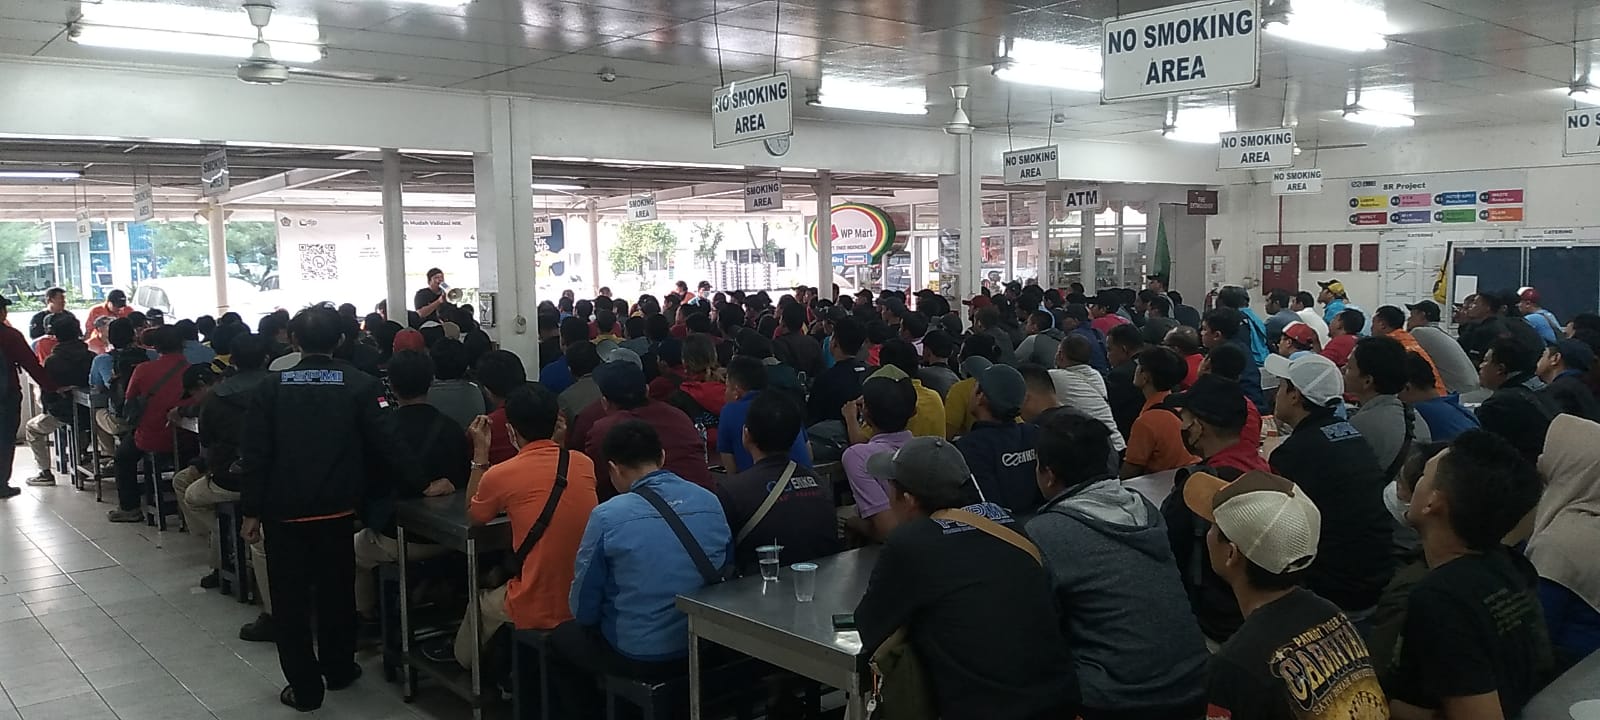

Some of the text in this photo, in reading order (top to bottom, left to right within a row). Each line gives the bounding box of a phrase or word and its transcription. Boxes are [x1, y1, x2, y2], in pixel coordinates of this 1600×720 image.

[1108, 9, 1253, 54] NO SMOKING
[1145, 55, 1206, 85] AREA
[715, 81, 787, 113] NO SMOKING
[735, 113, 766, 134] AREA
[1568, 114, 1590, 129] NO
[1221, 132, 1292, 148] NO SMOKING
[1005, 150, 1056, 167] NO SMOKING
[1240, 151, 1270, 164] AREA
[1020, 167, 1041, 179] AREA
[1273, 170, 1321, 181] NO SMOKING
[746, 183, 779, 196] SMOKING
[1287, 182, 1307, 191] AREA
[1396, 182, 1426, 191] Project
[629, 197, 654, 208] SMOKING
[753, 197, 772, 208] AREA
[1066, 190, 1098, 207] ATM
[841, 227, 873, 238] WP Mart
